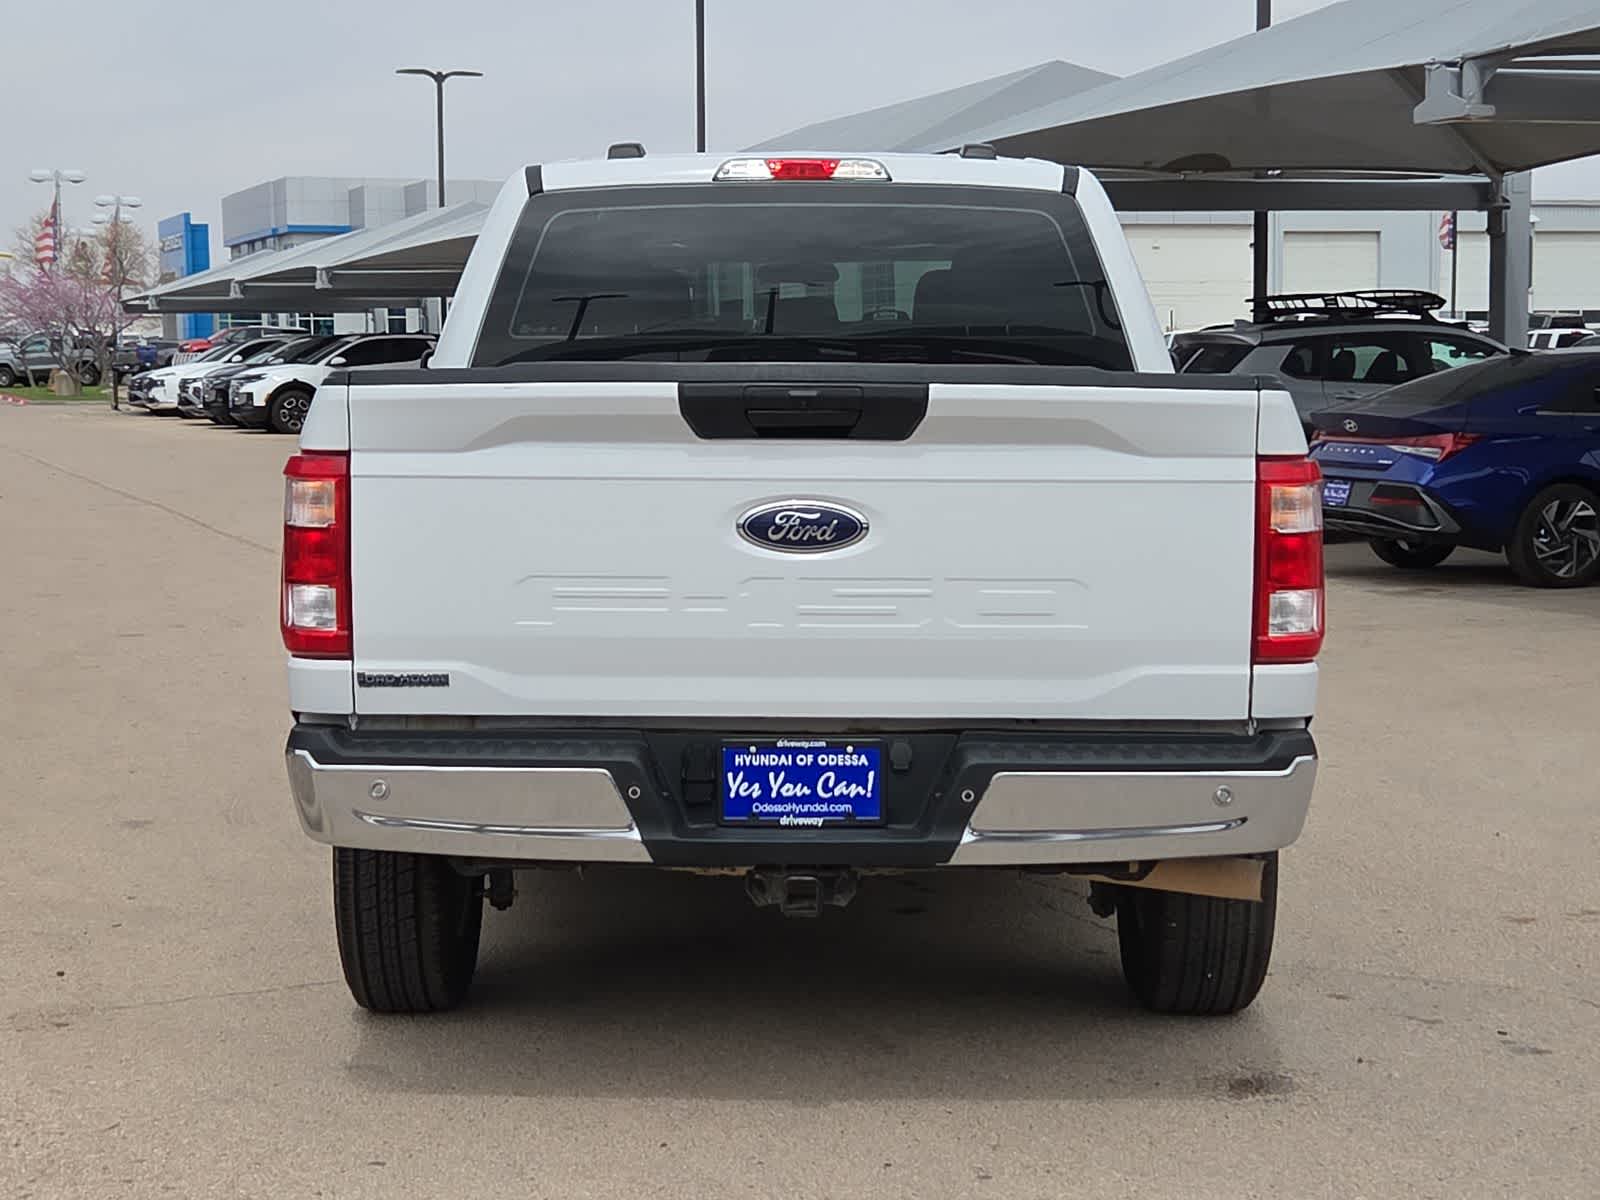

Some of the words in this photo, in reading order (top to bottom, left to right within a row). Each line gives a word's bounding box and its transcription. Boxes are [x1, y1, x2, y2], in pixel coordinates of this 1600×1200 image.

[768, 511, 839, 541] Ford
[735, 754, 792, 766] HYUNDAI
[796, 754, 814, 766] OF
[817, 754, 869, 766] ODESSA
[727, 771, 762, 798] Yes
[768, 771, 811, 798] You
[817, 770, 875, 798] Can!
[752, 802, 852, 814] OdessaHyundai.com
[780, 814, 824, 827] driveway
